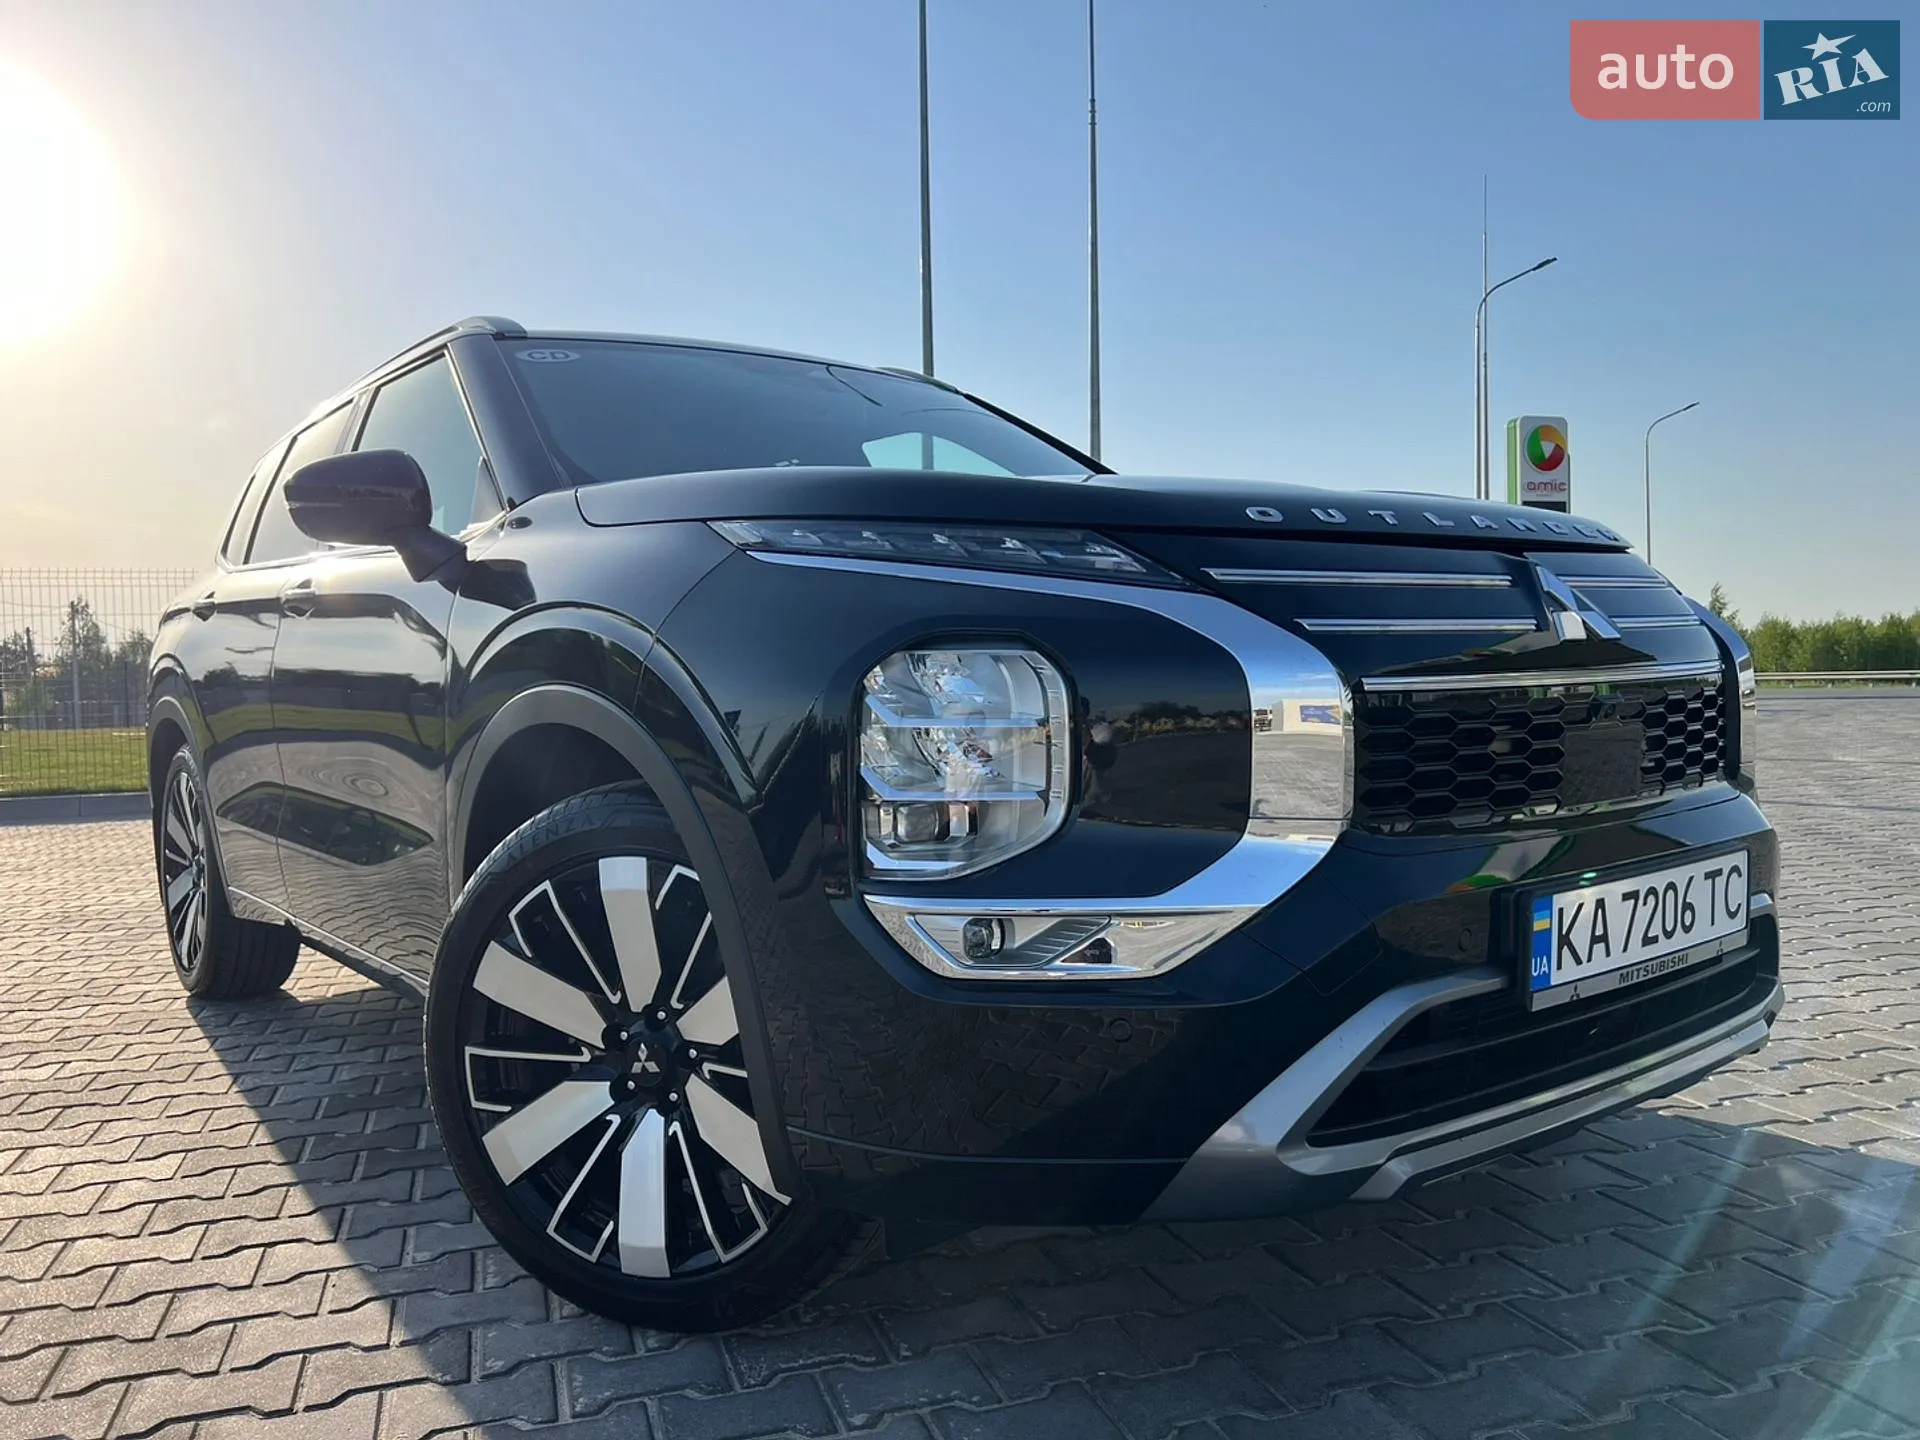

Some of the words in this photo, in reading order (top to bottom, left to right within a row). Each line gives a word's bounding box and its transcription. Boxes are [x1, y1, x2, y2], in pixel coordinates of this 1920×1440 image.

[526, 350, 571, 360] CD
[1245, 506, 1620, 542] OUTLANDER
[1556, 896, 1611, 972] KA
[1621, 874, 1696, 954] 7206
[1704, 864, 1743, 927] TC
[1532, 954, 1549, 977] UA
[1618, 952, 1690, 986] MITSUBISHI
